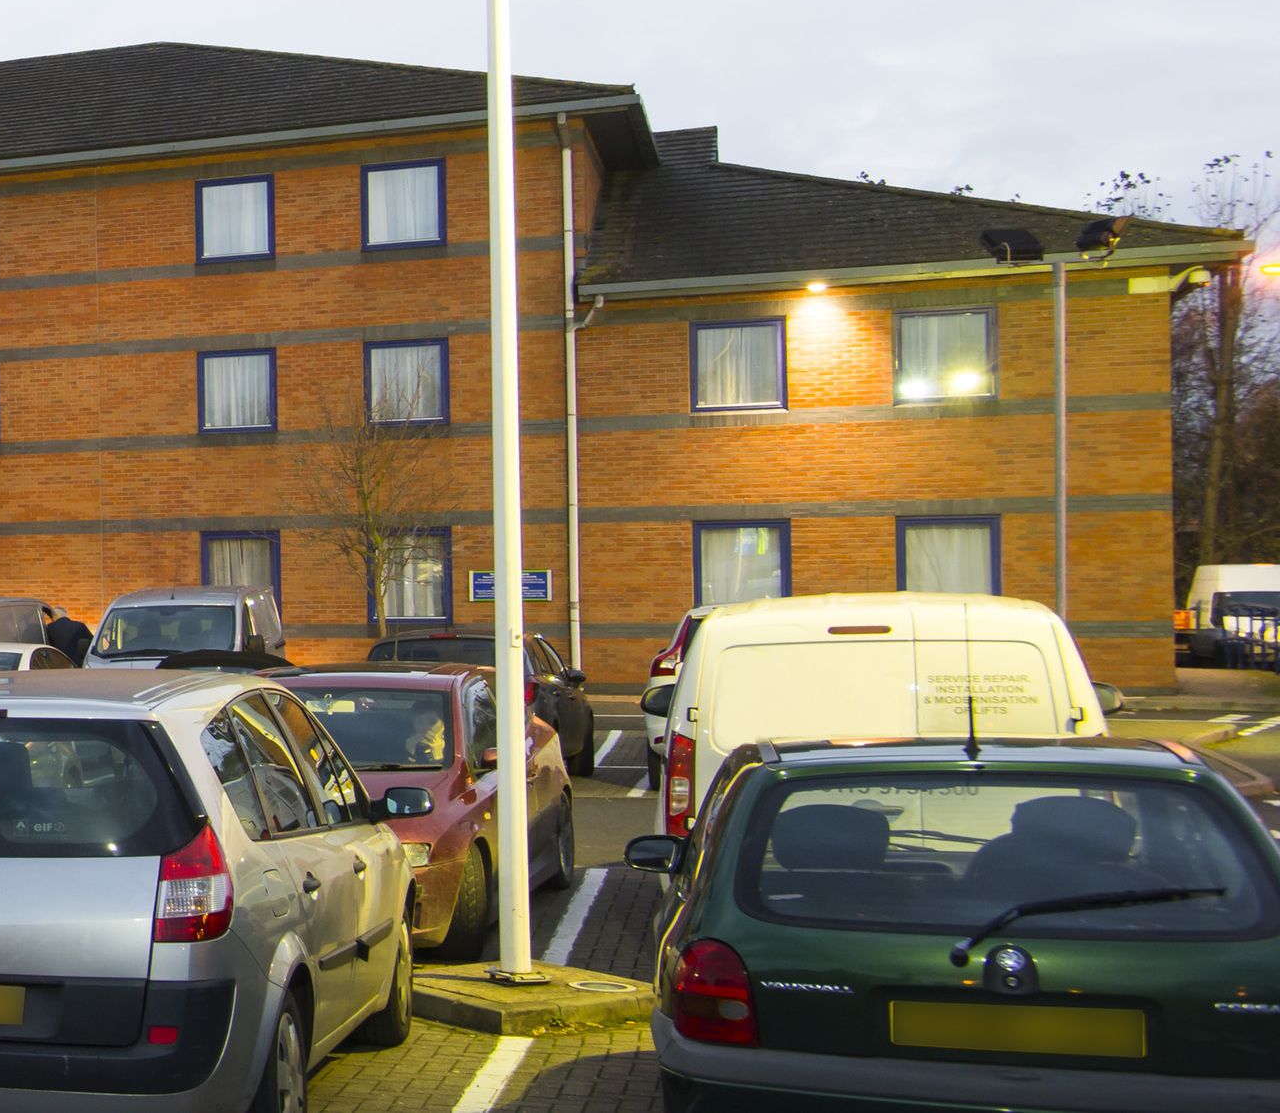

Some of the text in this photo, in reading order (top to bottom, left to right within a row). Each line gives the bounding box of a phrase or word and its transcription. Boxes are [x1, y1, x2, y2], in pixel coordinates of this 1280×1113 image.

[927, 675, 980, 683] SERVICE
[935, 685, 1025, 694] INSTALLATION
[934, 695, 1038, 704] MODERNISATION
[974, 706, 1008, 715] LIFTS
